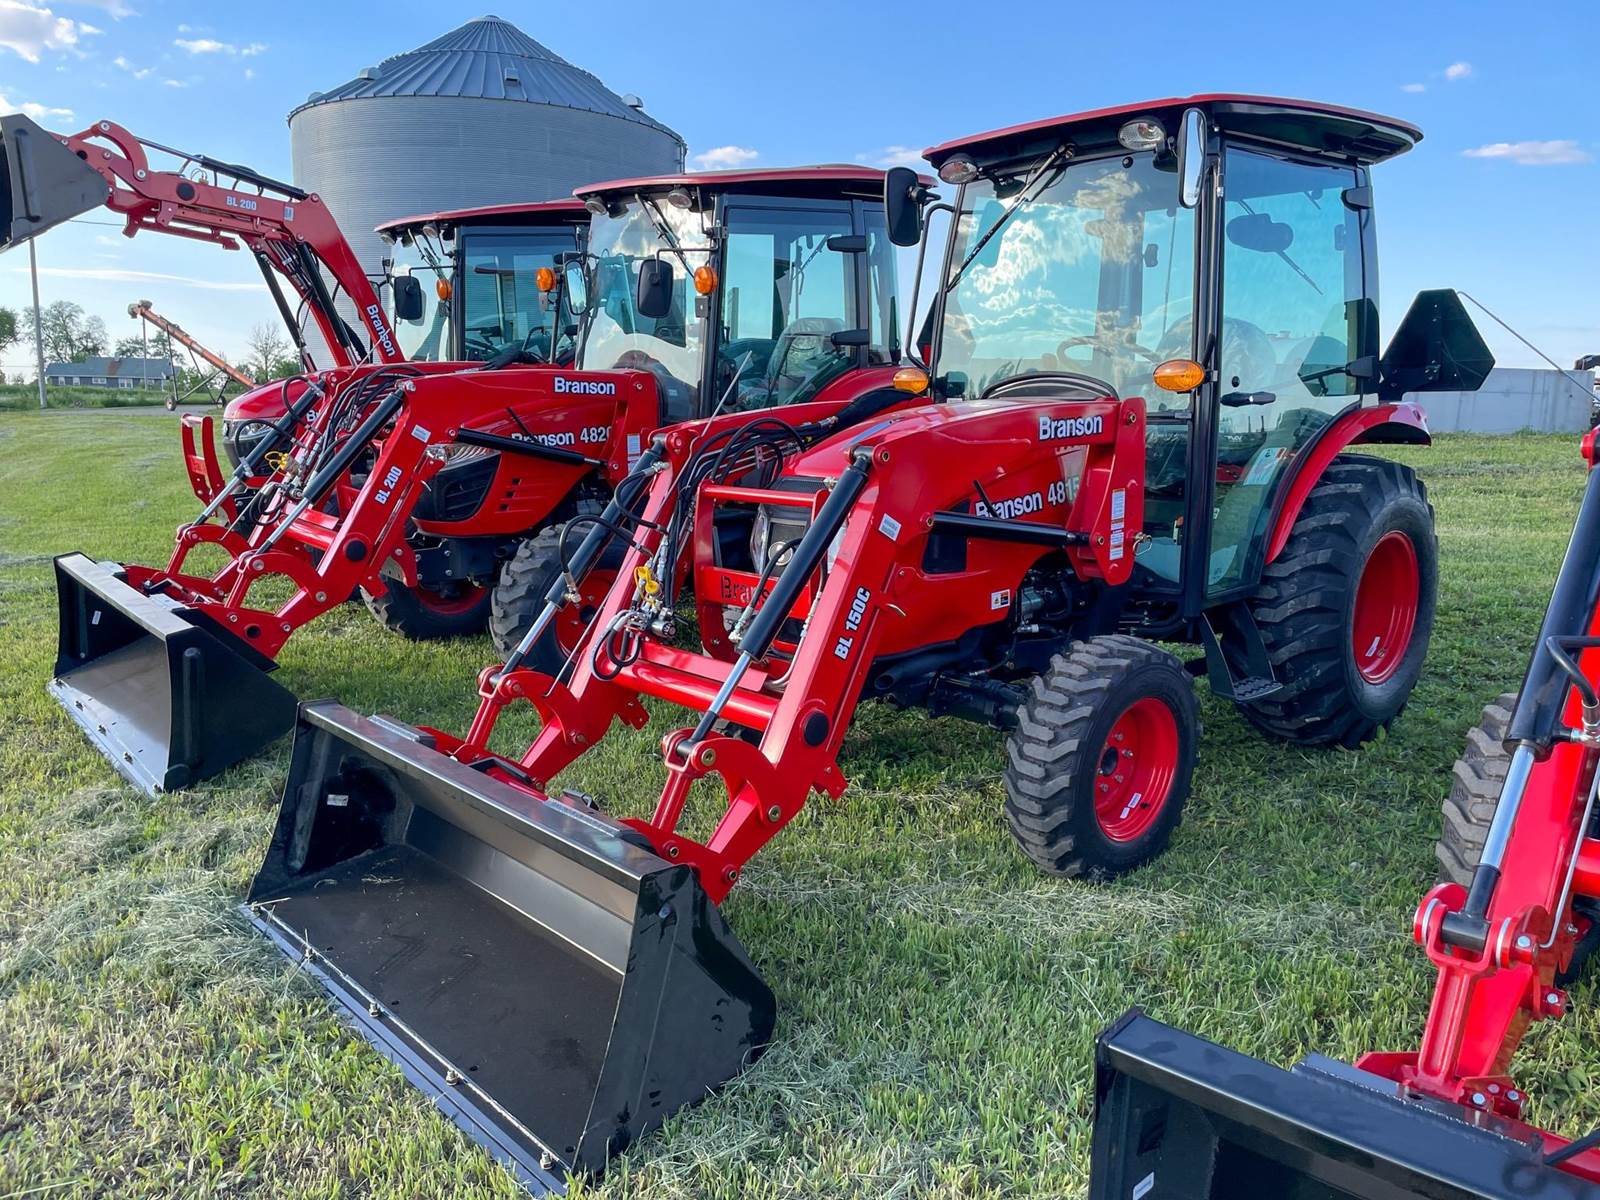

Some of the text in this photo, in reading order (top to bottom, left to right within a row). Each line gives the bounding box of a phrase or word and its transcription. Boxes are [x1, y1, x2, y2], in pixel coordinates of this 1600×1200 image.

[226, 195, 256, 210] BL 200
[366, 304, 396, 357] Branson
[554, 376, 615, 394] Branson
[1039, 415, 1102, 440] Branson
[374, 465, 403, 505] BL 200
[834, 586, 871, 660] BL 150C
